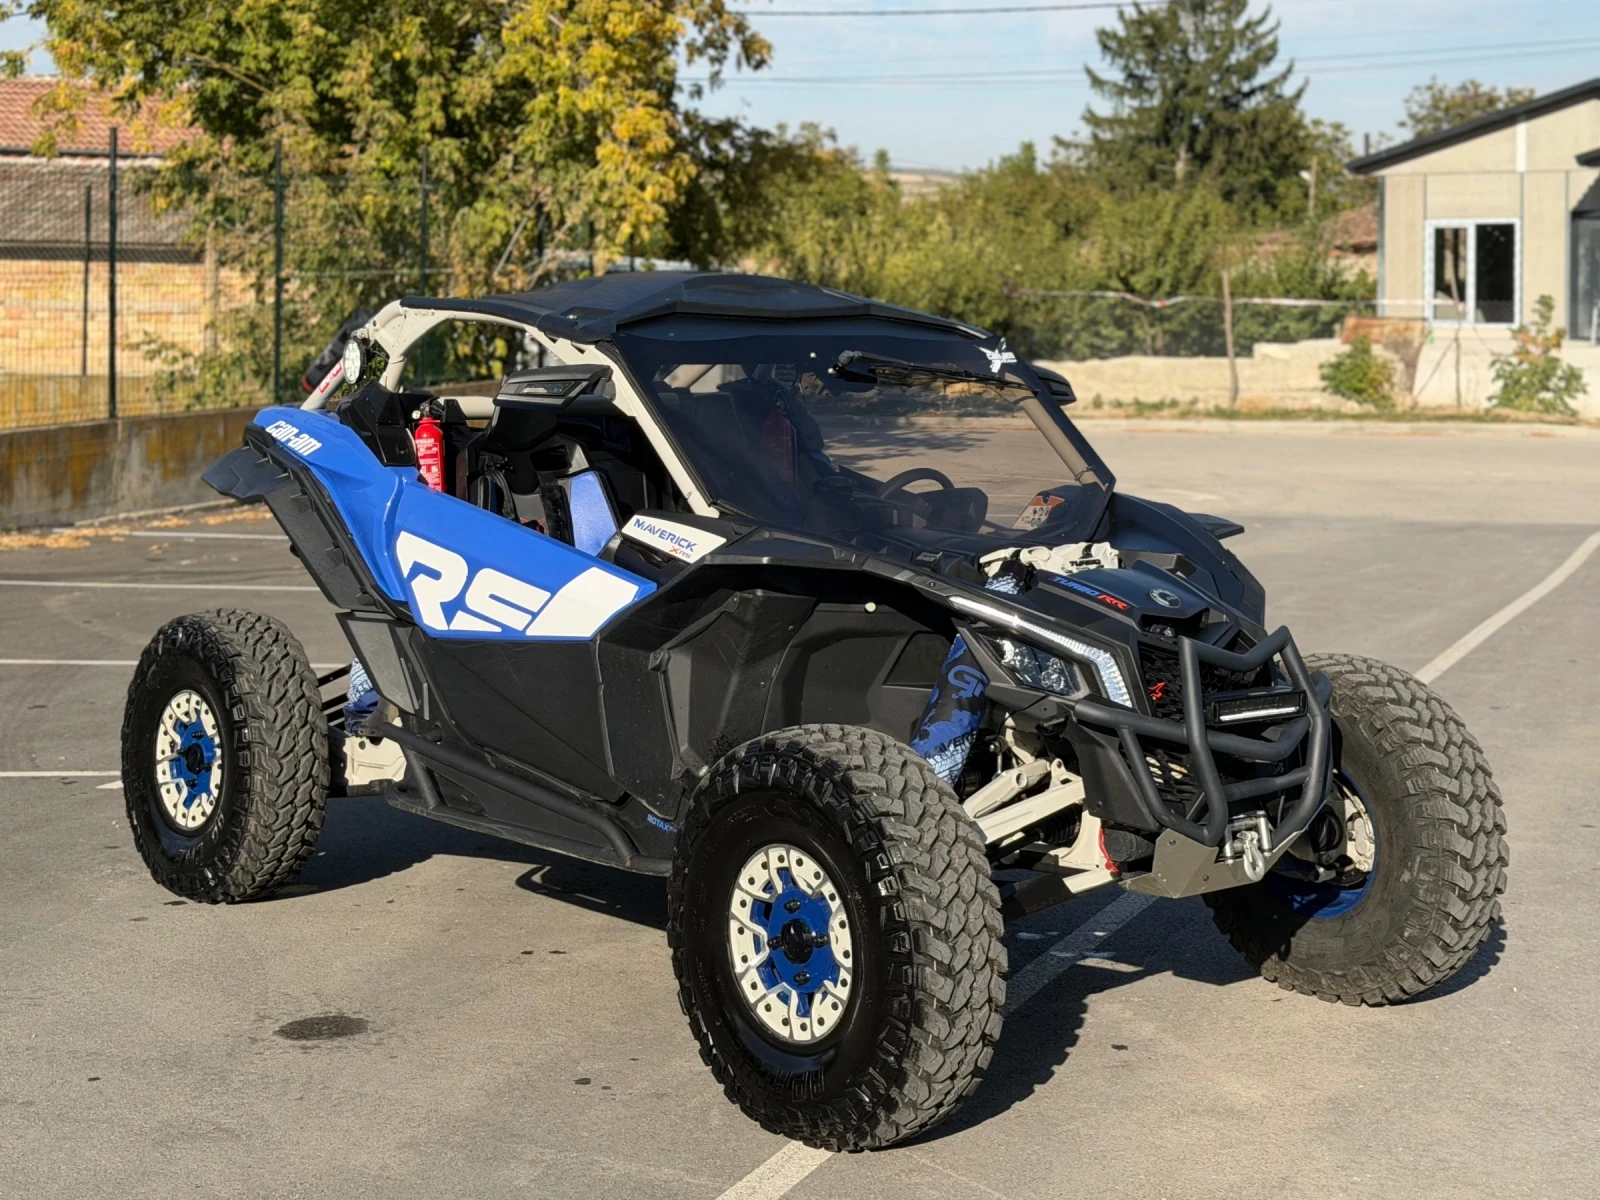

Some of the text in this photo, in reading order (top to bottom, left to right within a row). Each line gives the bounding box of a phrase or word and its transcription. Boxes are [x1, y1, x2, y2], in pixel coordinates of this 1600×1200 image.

[265, 420, 323, 456] can-am
[633, 517, 698, 552] MAVERICK
[1069, 558, 1102, 567] TURBO
[1054, 576, 1128, 610] TURBO RR
[647, 813, 670, 832] ROTAX
